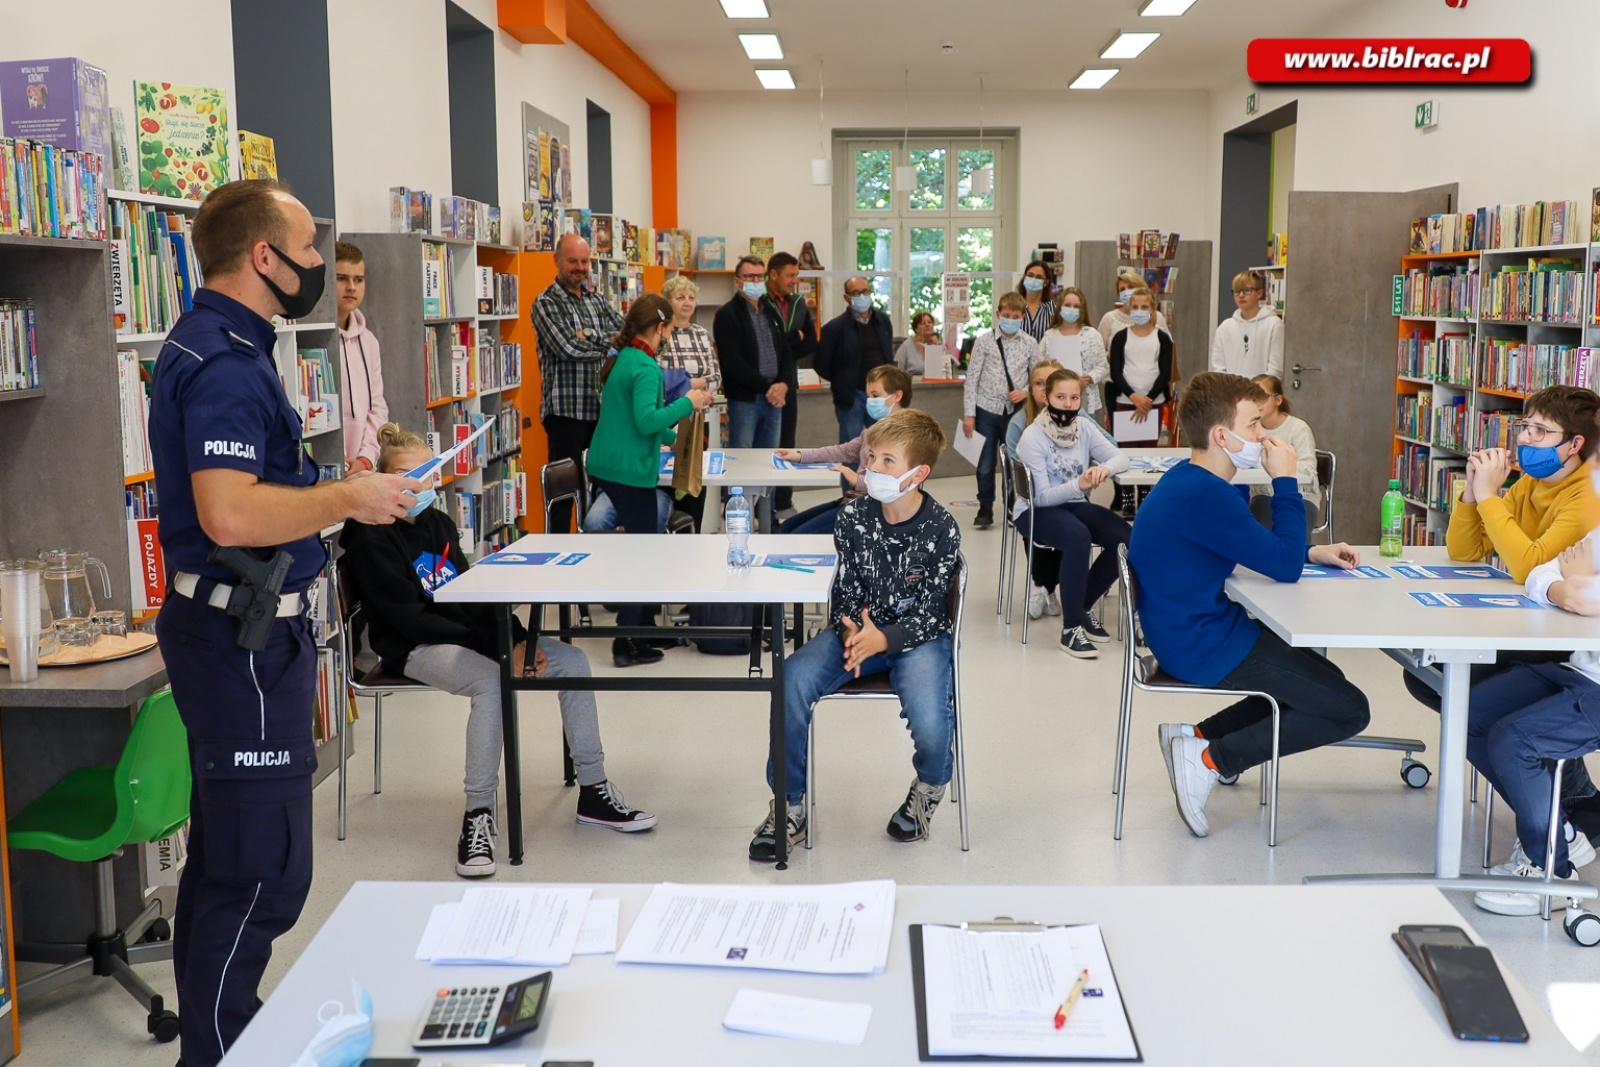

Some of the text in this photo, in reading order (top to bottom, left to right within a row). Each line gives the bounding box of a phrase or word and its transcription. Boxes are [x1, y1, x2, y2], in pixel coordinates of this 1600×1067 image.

[167, 129, 205, 140] jedzenie?
[204, 441, 257, 461] POLICJA
[144, 534, 158, 588] POJAZDY
[234, 750, 291, 767] POLICJA
[158, 839, 171, 872] EMIA
